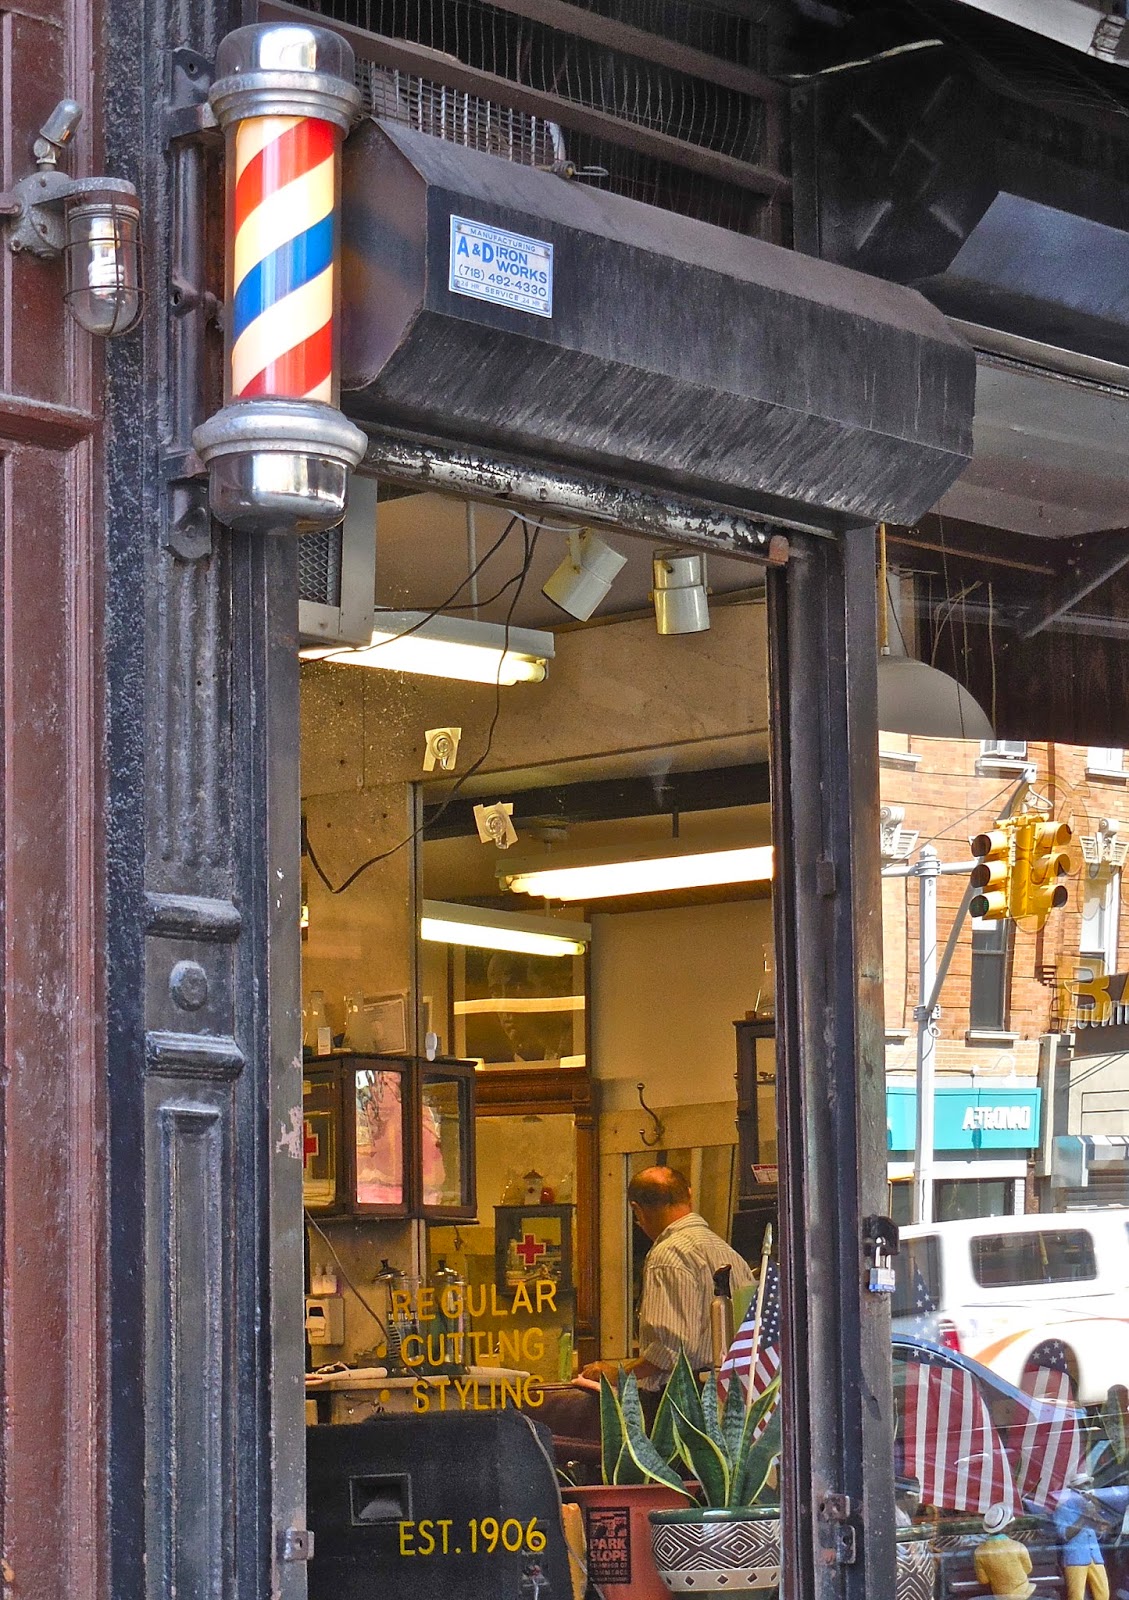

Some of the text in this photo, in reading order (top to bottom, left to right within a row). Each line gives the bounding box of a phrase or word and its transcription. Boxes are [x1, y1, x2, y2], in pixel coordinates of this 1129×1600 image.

[470, 228, 536, 252] MANUFACTURING
[496, 245, 528, 265] IRON
[459, 263, 547, 297] (718) 492-4330
[496, 260, 547, 284] WORKS
[485, 286, 519, 301] SERVICE
[391, 1279, 558, 1323] REGULAR
[401, 1327, 545, 1367] CUTTING
[412, 1375, 545, 1414] STYLING
[589, 1538, 627, 1550] PARK
[590, 1550, 627, 1561] SLOPE
